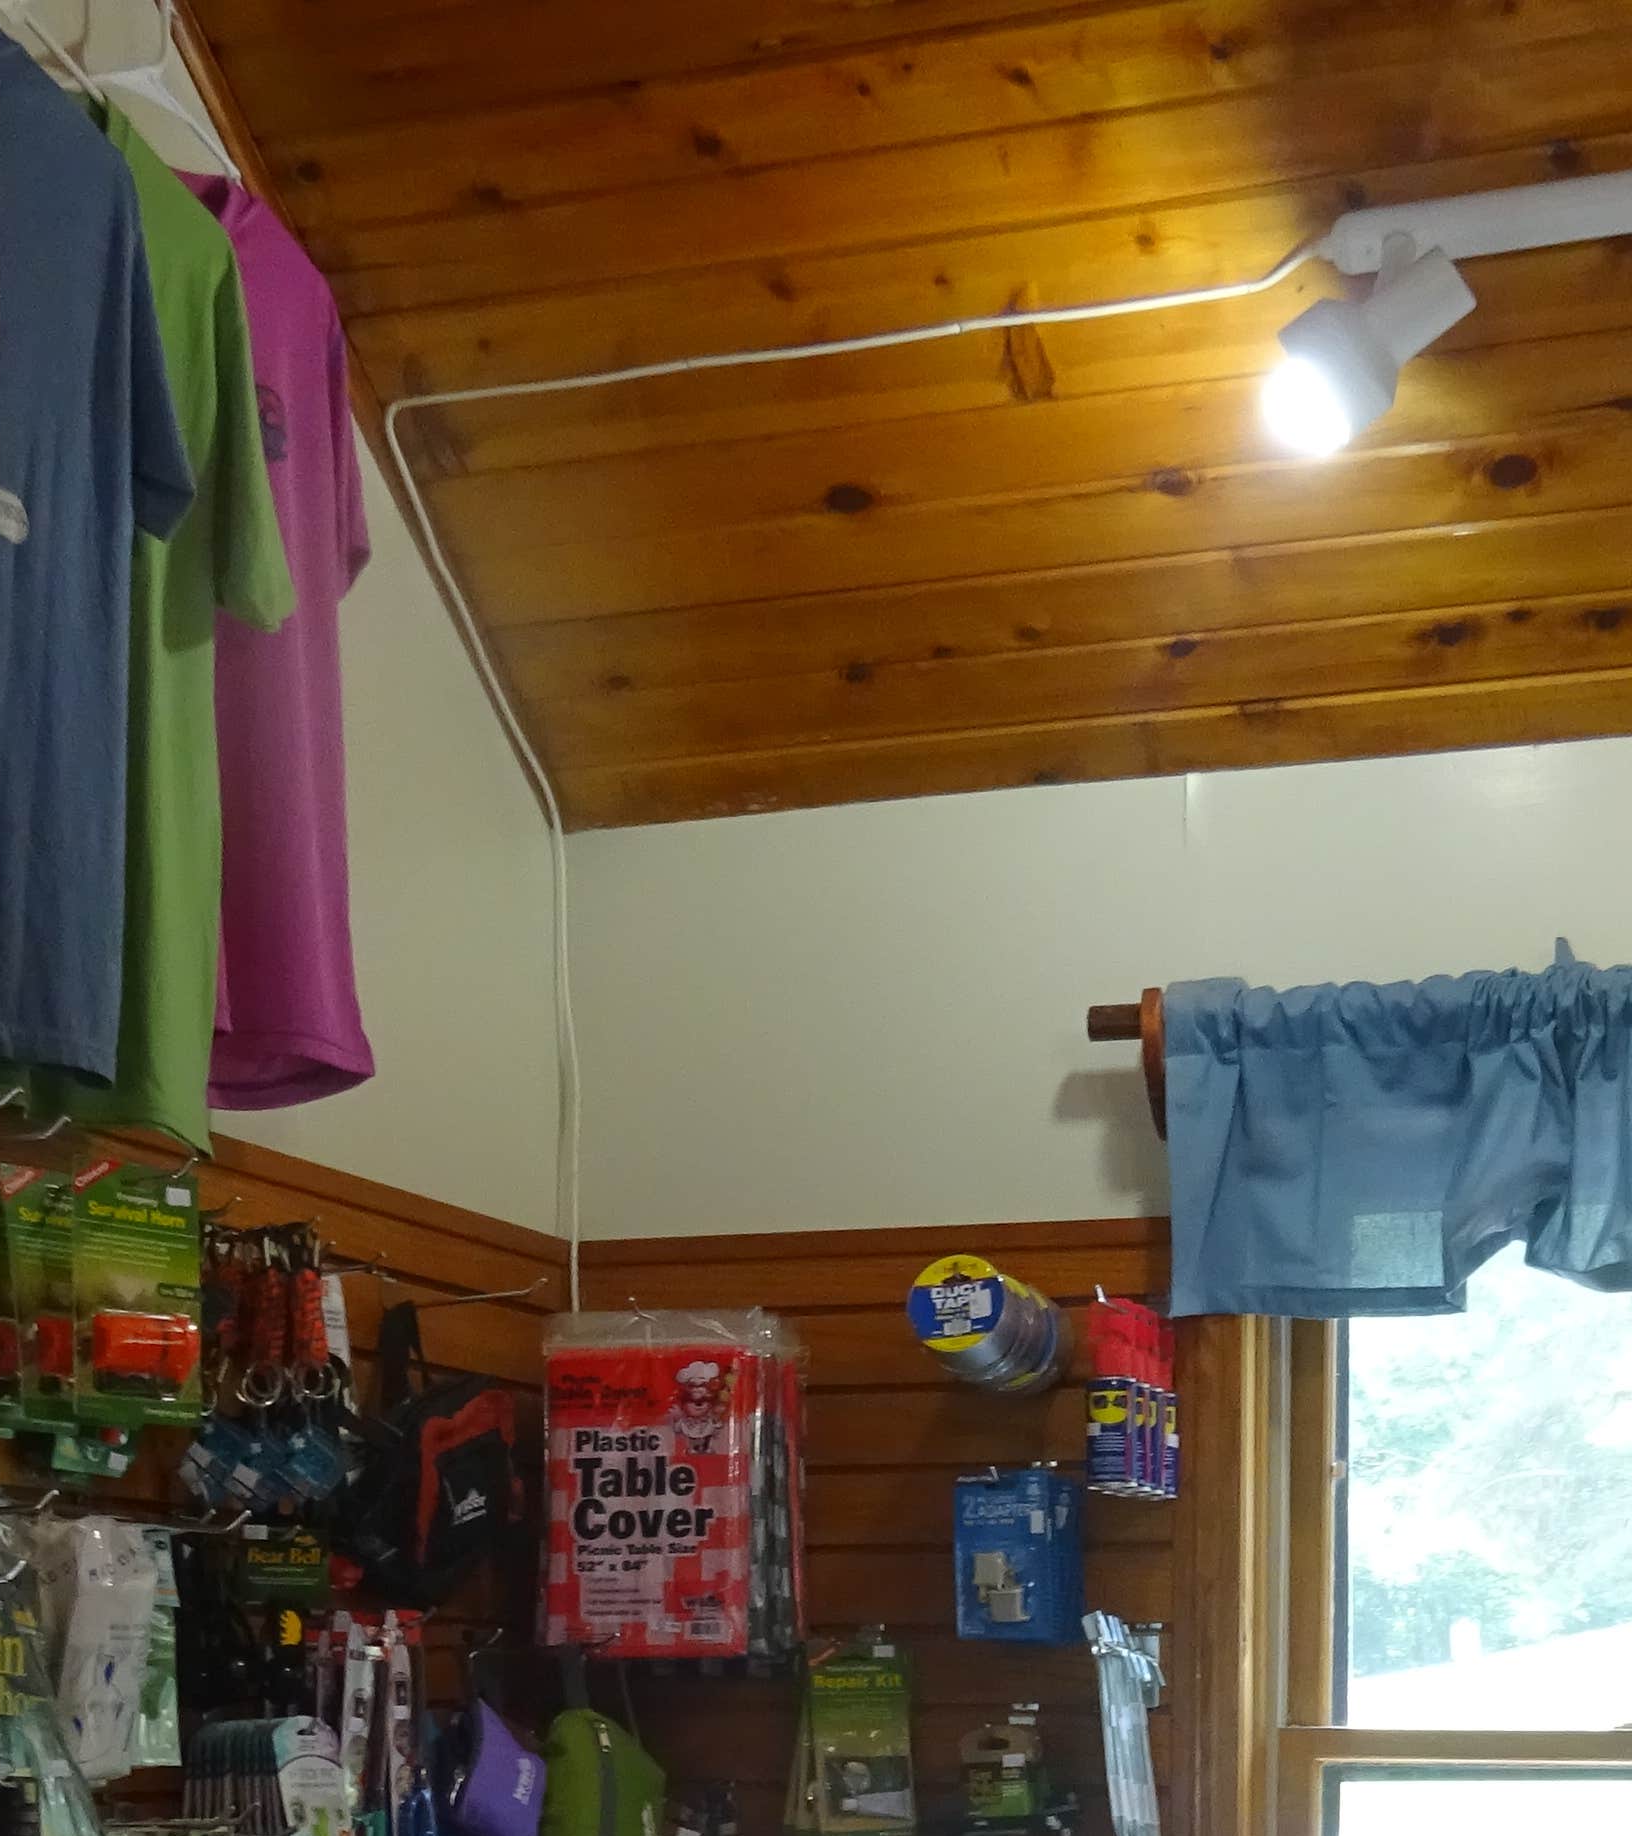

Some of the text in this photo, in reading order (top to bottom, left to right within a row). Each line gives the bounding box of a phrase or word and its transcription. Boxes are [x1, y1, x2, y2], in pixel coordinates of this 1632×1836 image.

[932, 1299, 973, 1311] TAP
[575, 1430, 661, 1453] Plastic
[574, 1456, 696, 1498] Table
[574, 1498, 714, 1540] Cover
[576, 1543, 697, 1556] Picnic Table Size
